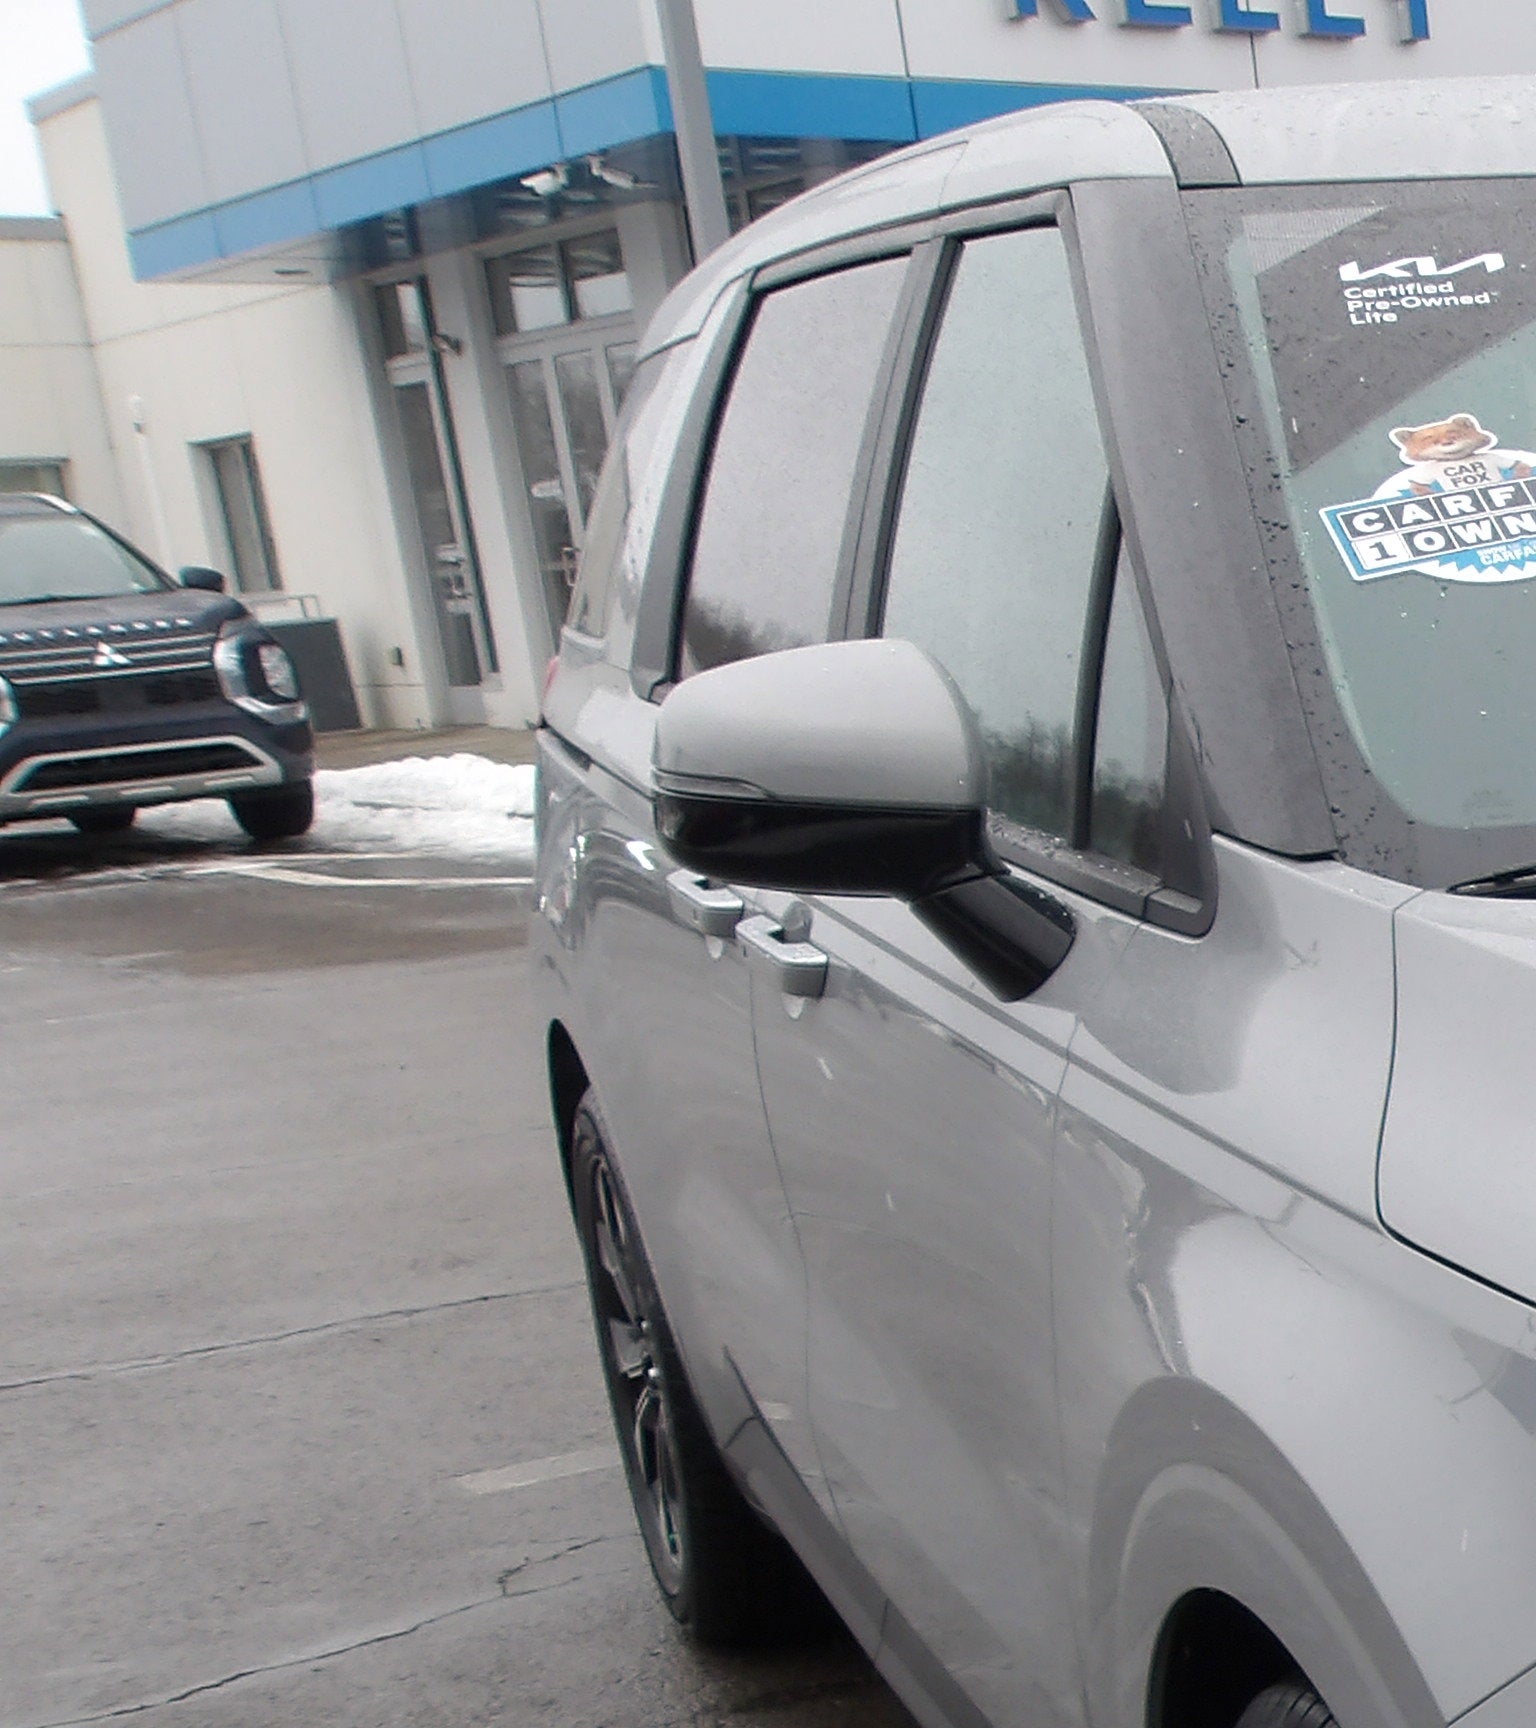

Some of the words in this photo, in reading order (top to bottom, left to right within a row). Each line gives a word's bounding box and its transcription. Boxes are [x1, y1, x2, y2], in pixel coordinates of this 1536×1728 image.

[1344, 281, 1455, 299] Certified
[1350, 312, 1398, 325] Lite
[1443, 461, 1487, 477] CAR
[1450, 472, 1491, 488] FOX
[1368, 541, 1400, 564] 1
